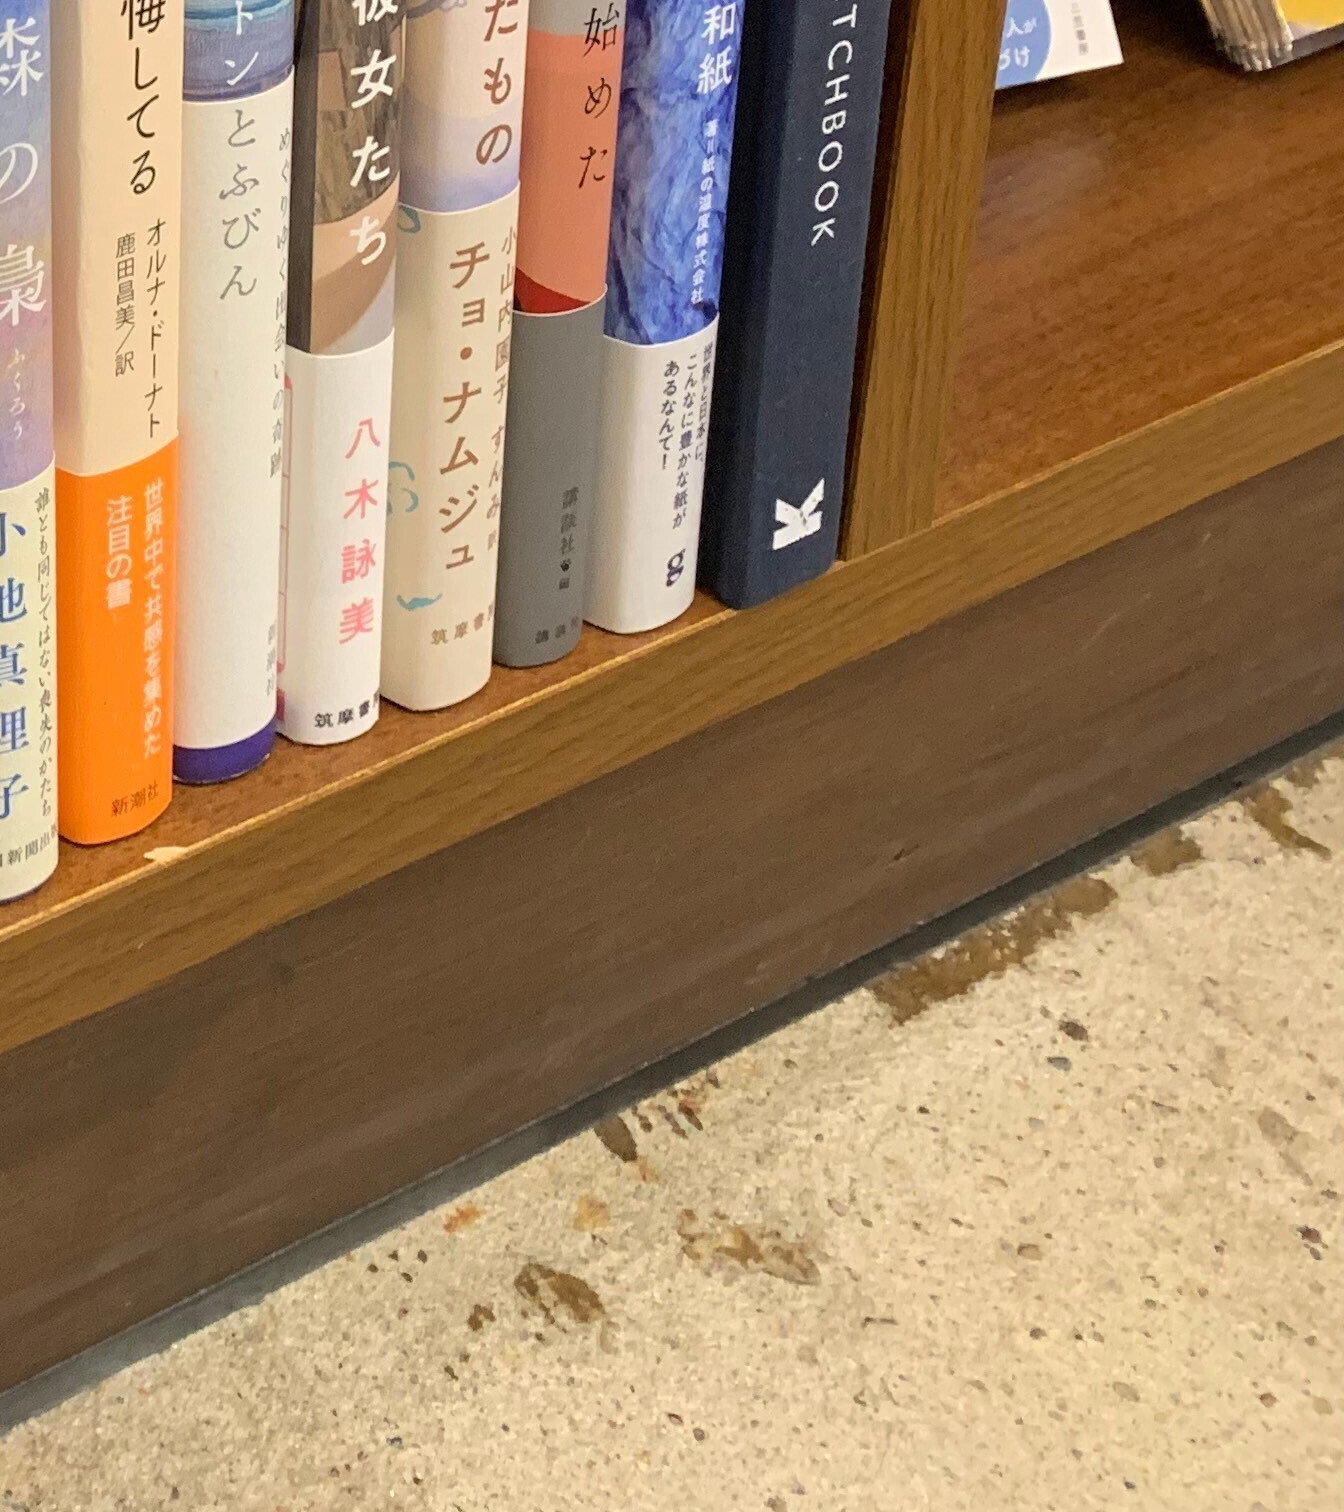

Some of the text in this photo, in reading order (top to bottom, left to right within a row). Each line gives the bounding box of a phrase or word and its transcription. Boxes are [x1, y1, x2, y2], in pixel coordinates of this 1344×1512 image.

[7, 349, 28, 441] ふくろう
[143, 219, 167, 438] オルナ・ドーナト
[439, 241, 490, 570] チョ・ナムジュ
[106, 496, 132, 608] 注目の書
[141, 480, 165, 758] 世界中で共感を集めた
[338, 418, 382, 645] 八木詠美
[111, 780, 160, 818] 新潮社
